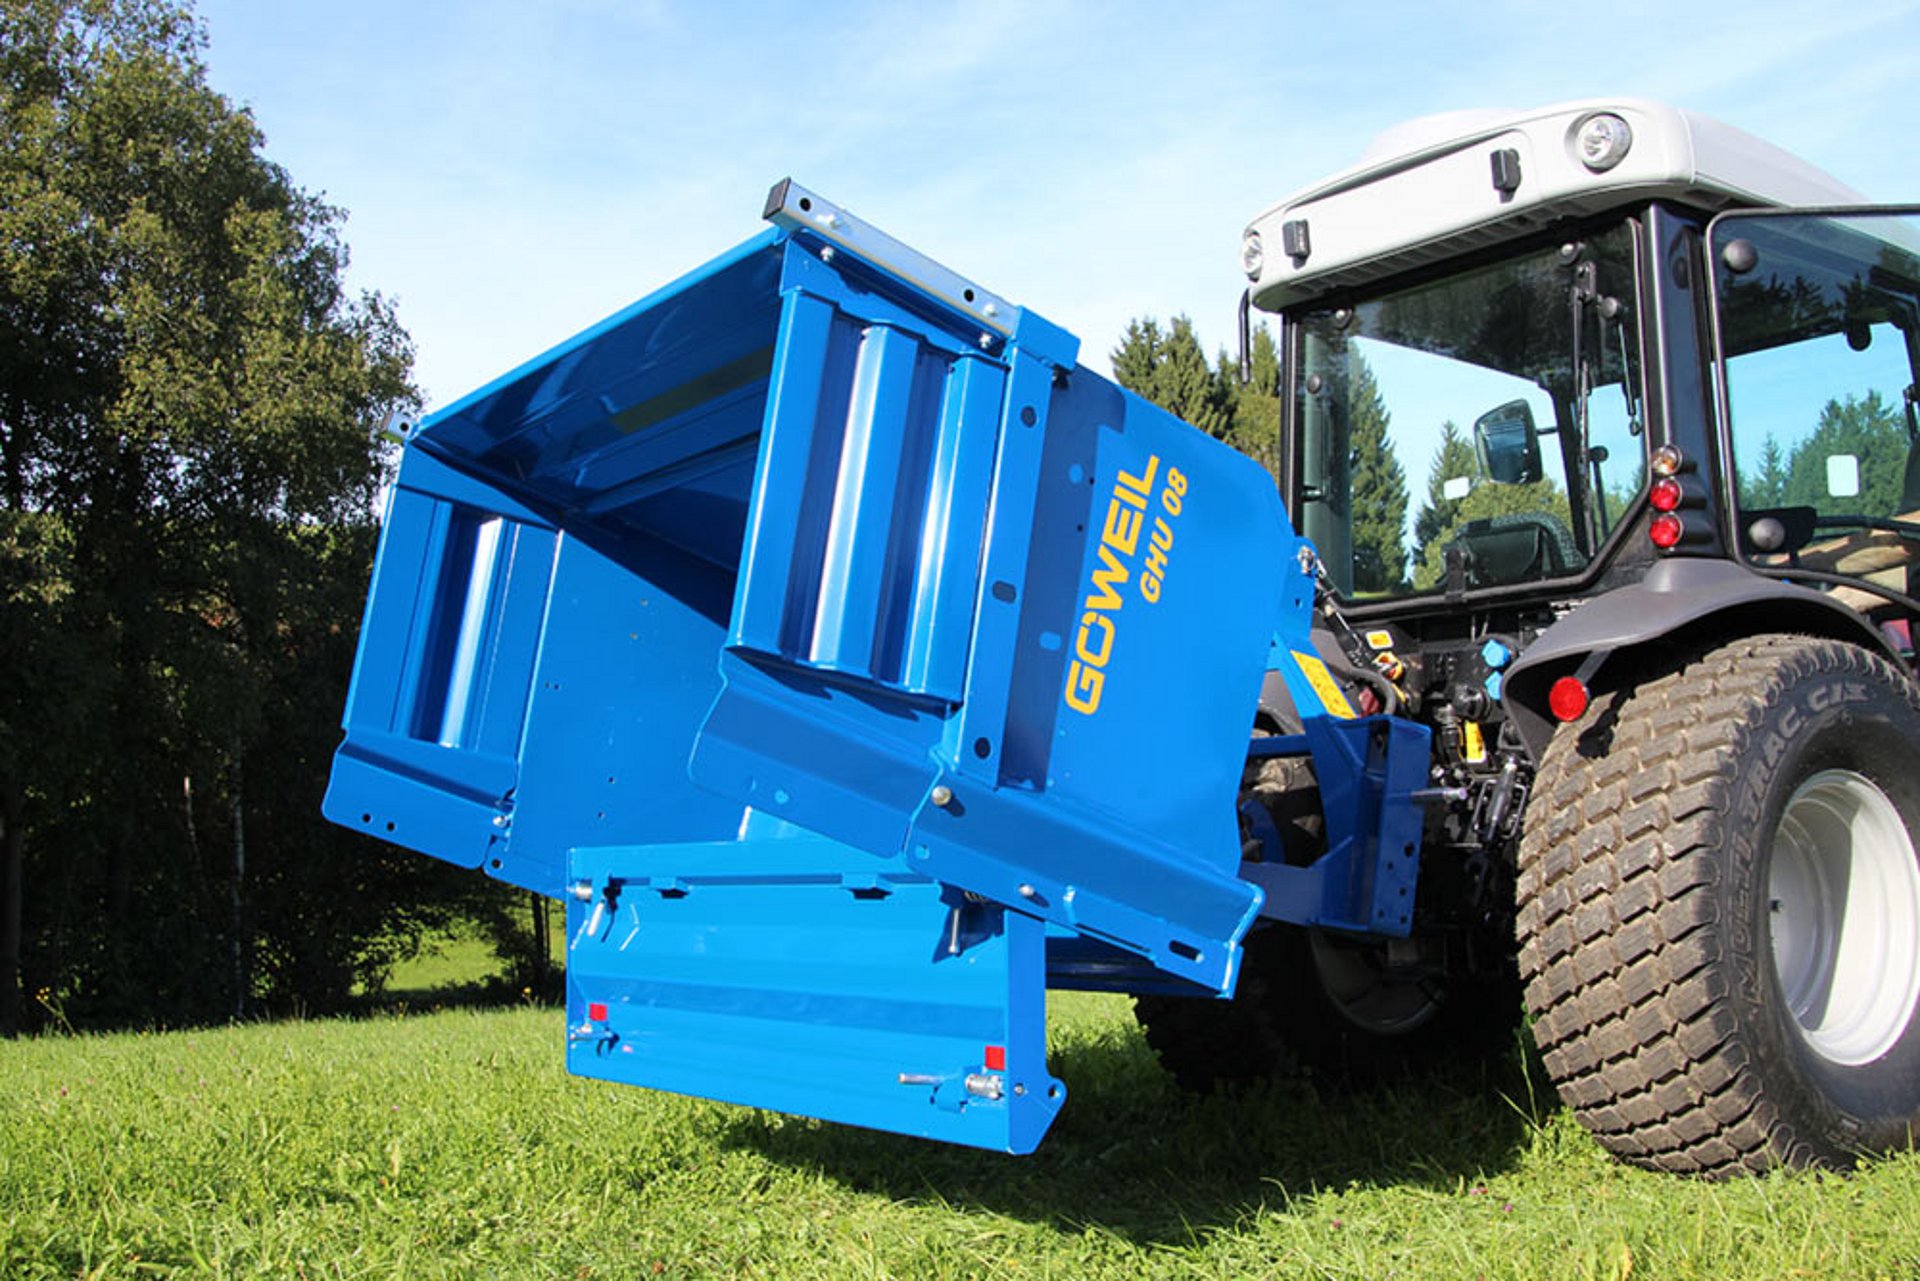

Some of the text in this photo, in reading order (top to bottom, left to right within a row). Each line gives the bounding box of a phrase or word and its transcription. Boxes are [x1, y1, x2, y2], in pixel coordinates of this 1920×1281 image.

[1140, 467, 1188, 603] GHU 08
[1740, 706, 1803, 823] TRAC
